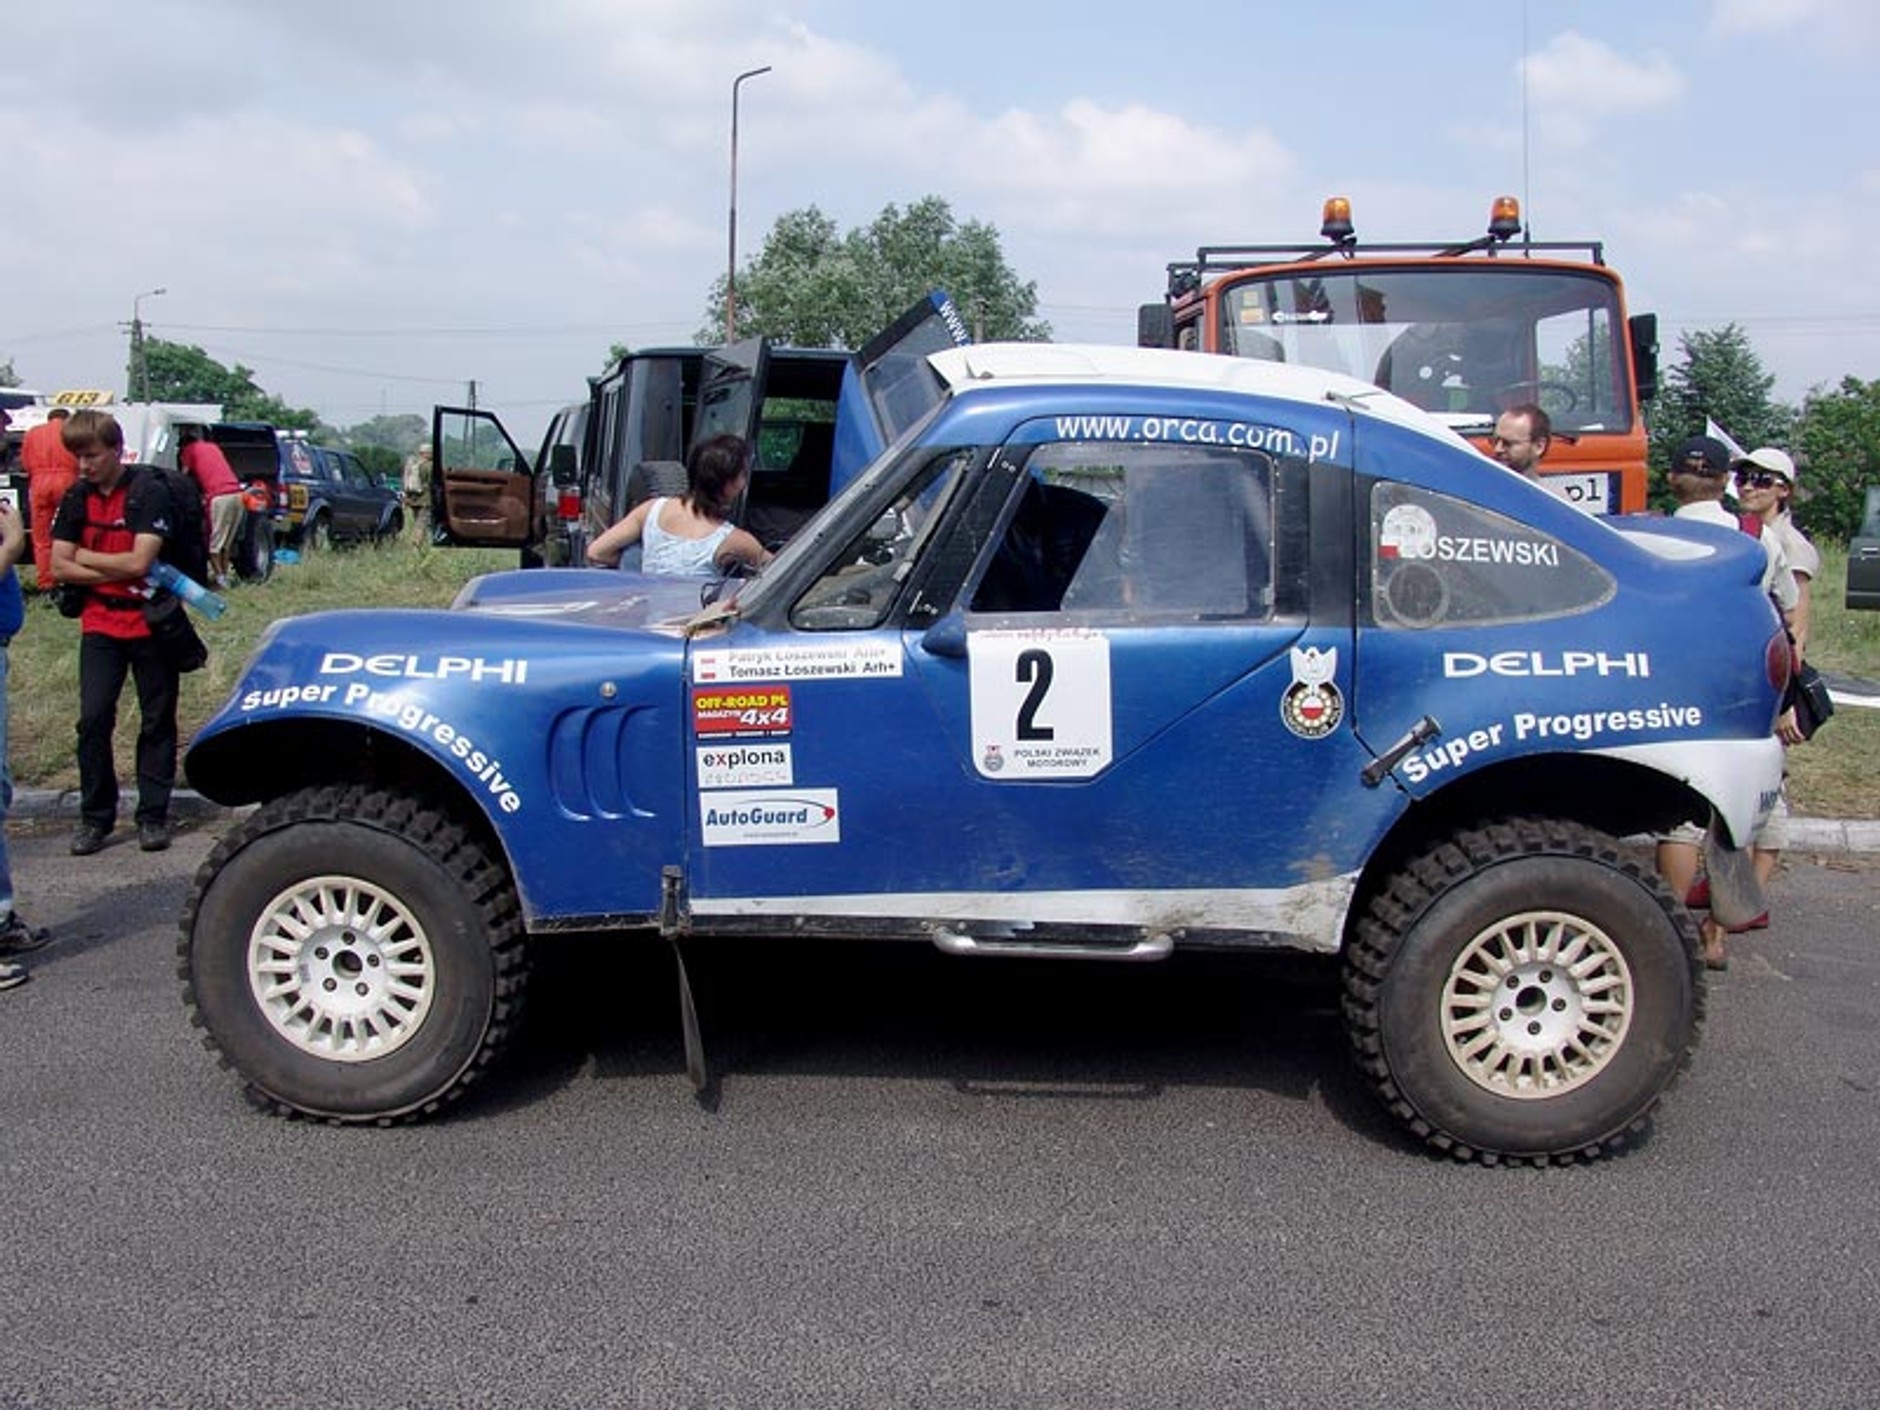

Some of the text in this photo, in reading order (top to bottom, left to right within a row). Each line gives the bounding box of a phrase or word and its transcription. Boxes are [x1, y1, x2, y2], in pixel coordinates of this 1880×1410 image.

[1055, 416, 1339, 463] www.orca.com.pl
[1400, 536, 1559, 566] OSZEWSKI
[320, 653, 527, 684] DELPHI
[729, 665, 781, 677] Tomasz
[784, 662, 856, 676] Łoszewski
[1443, 652, 1649, 678] DELPHI
[696, 695, 768, 709] OFF-ROAD
[1016, 648, 1054, 741] 2
[739, 707, 788, 725] 4x4
[345, 683, 521, 813] Progressive
[1014, 749, 1051, 758] POLSKI
[1402, 703, 1702, 782] Super Progressive
[703, 749, 785, 769] explona
[1027, 759, 1087, 767] MOTOROWY
[706, 808, 808, 826] AutoGuard
